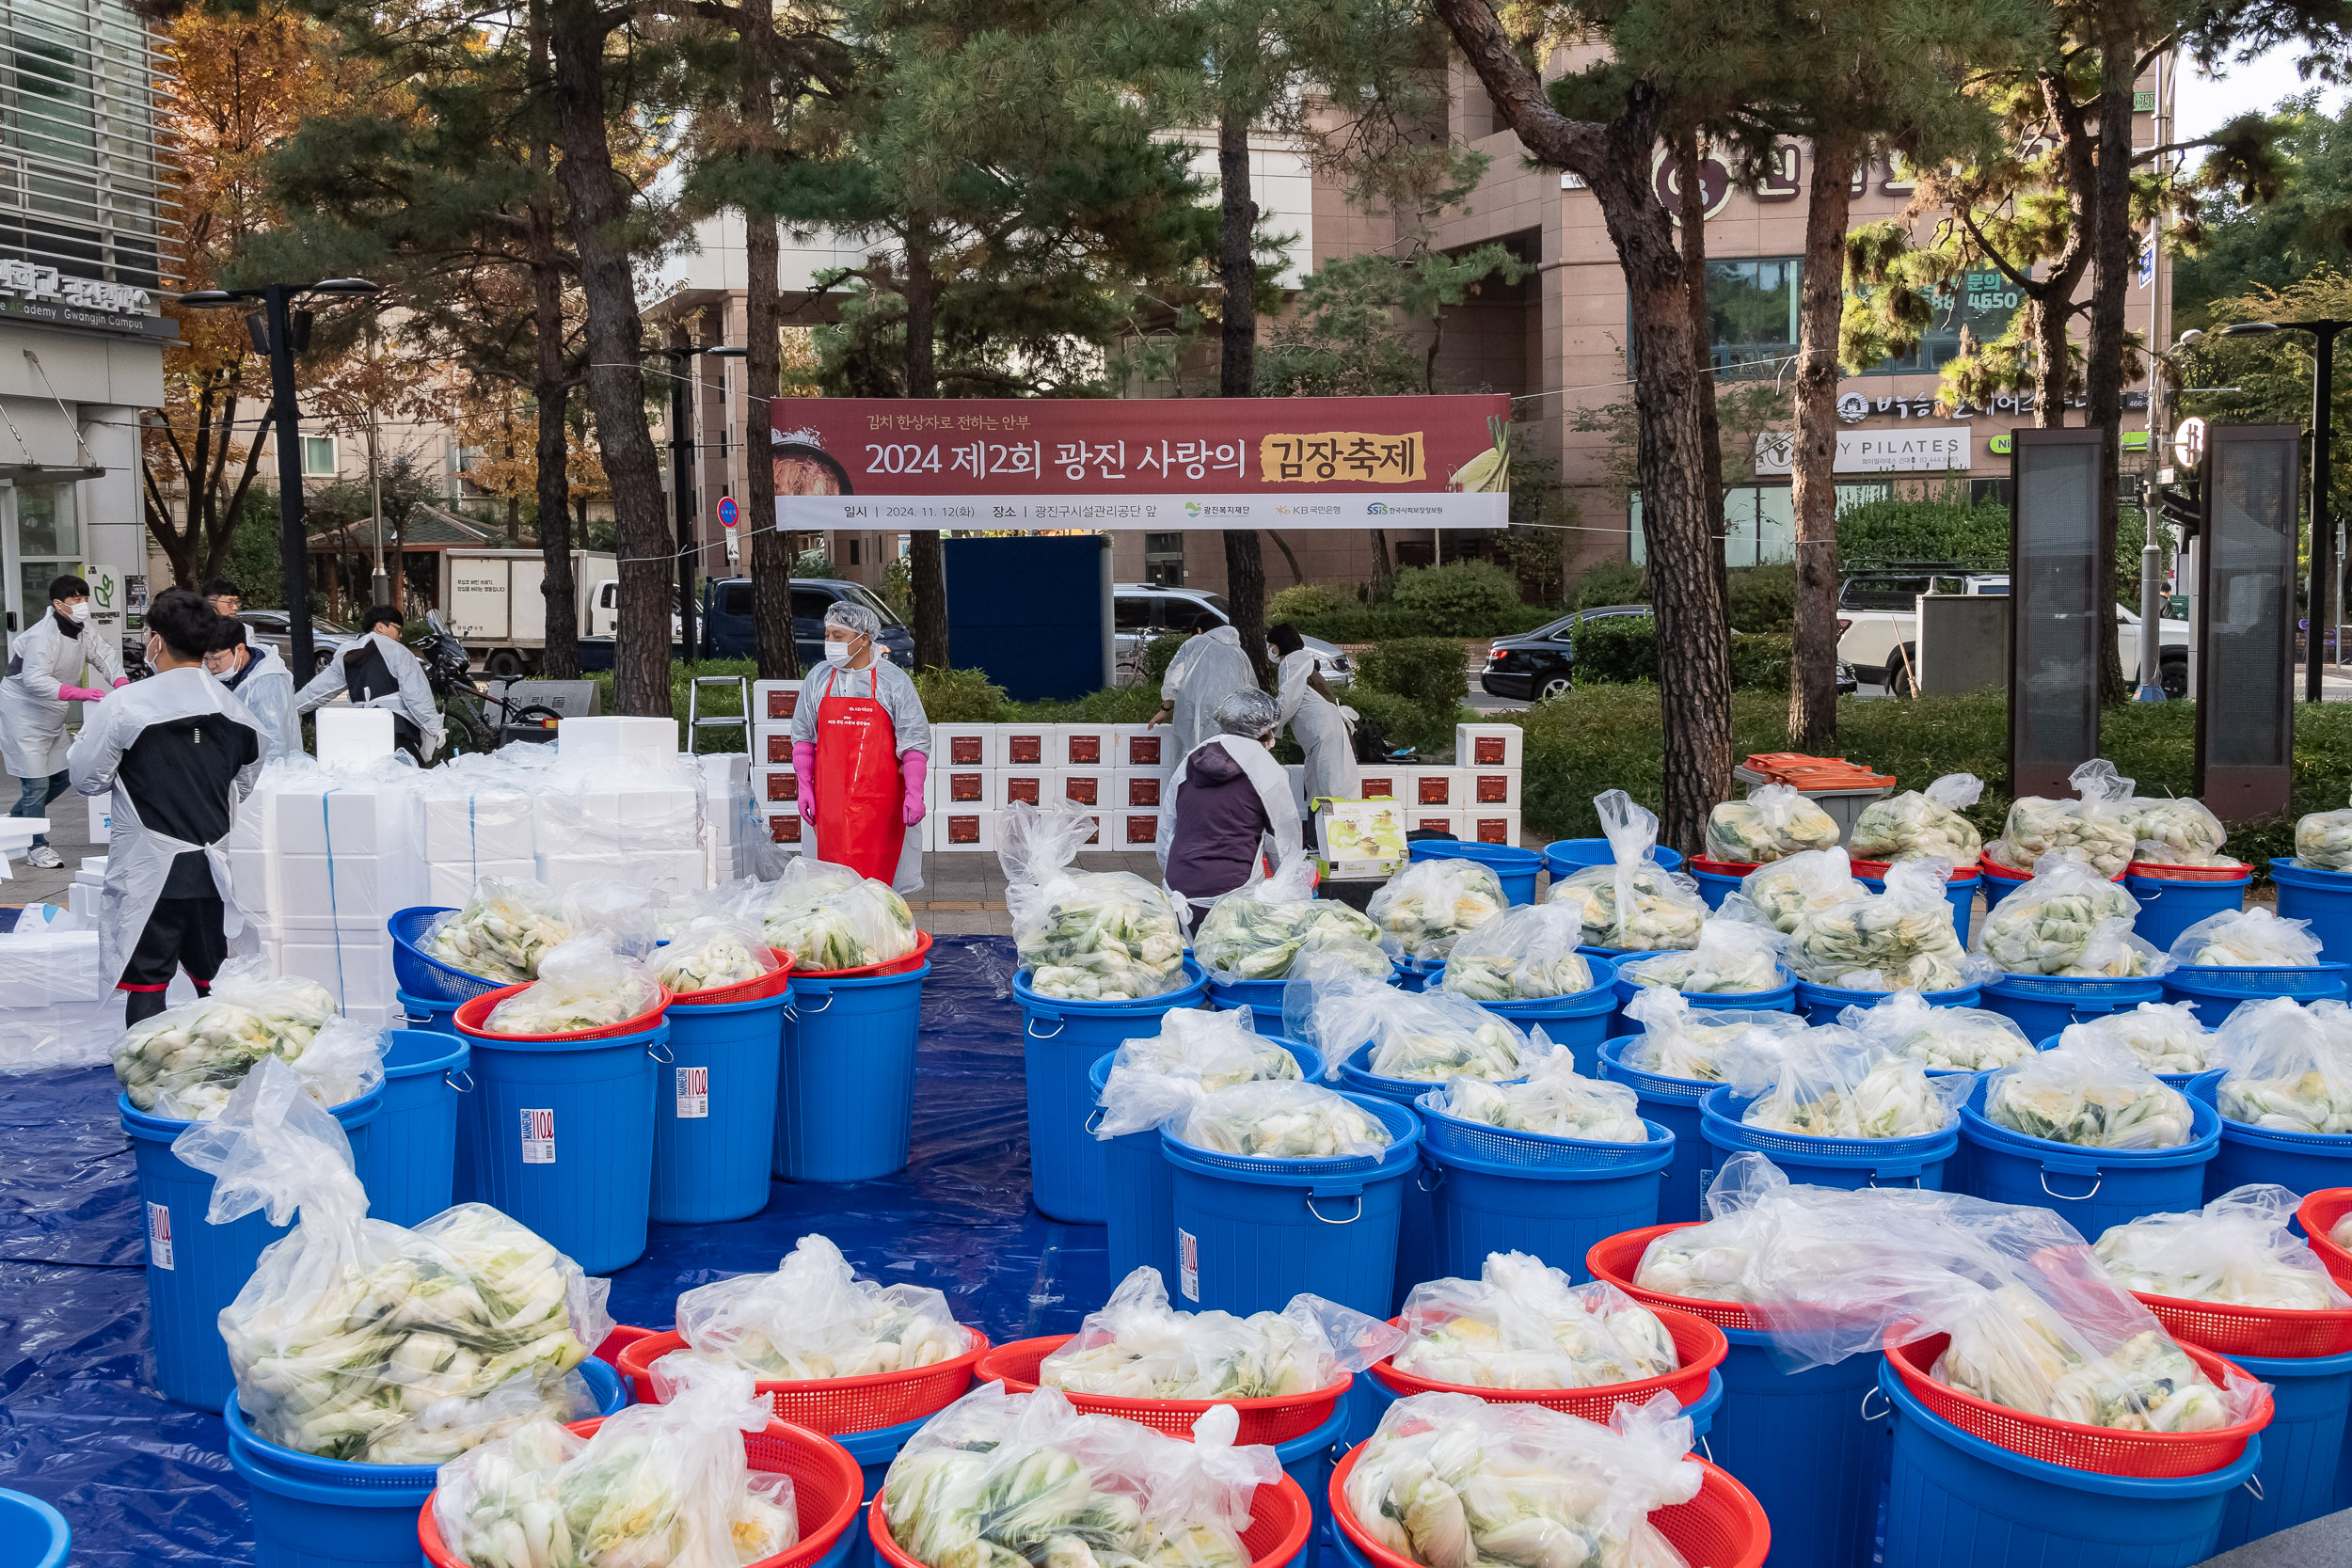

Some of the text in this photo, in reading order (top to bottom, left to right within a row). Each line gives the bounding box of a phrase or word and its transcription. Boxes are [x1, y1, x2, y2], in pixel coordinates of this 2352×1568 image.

[1967, 274, 2000, 292] 문의
[62, 278, 151, 314] 광진캠퍼스
[1967, 293, 2018, 309] 4650
[64, 309, 106, 326] Gwangjin
[108, 315, 143, 330] Campus
[866, 414, 1031, 431] 김치 한상자로 전하는 안부
[866, 436, 1414, 481] 2024 제2회 광진 사랑의 김장축제
[844, 505, 975, 519] 일시 2024. 11. 12(화)
[993, 504, 1157, 519] 장소 광진구시설관리공단 앞
[1203, 505, 1250, 515] 광진복지재단
